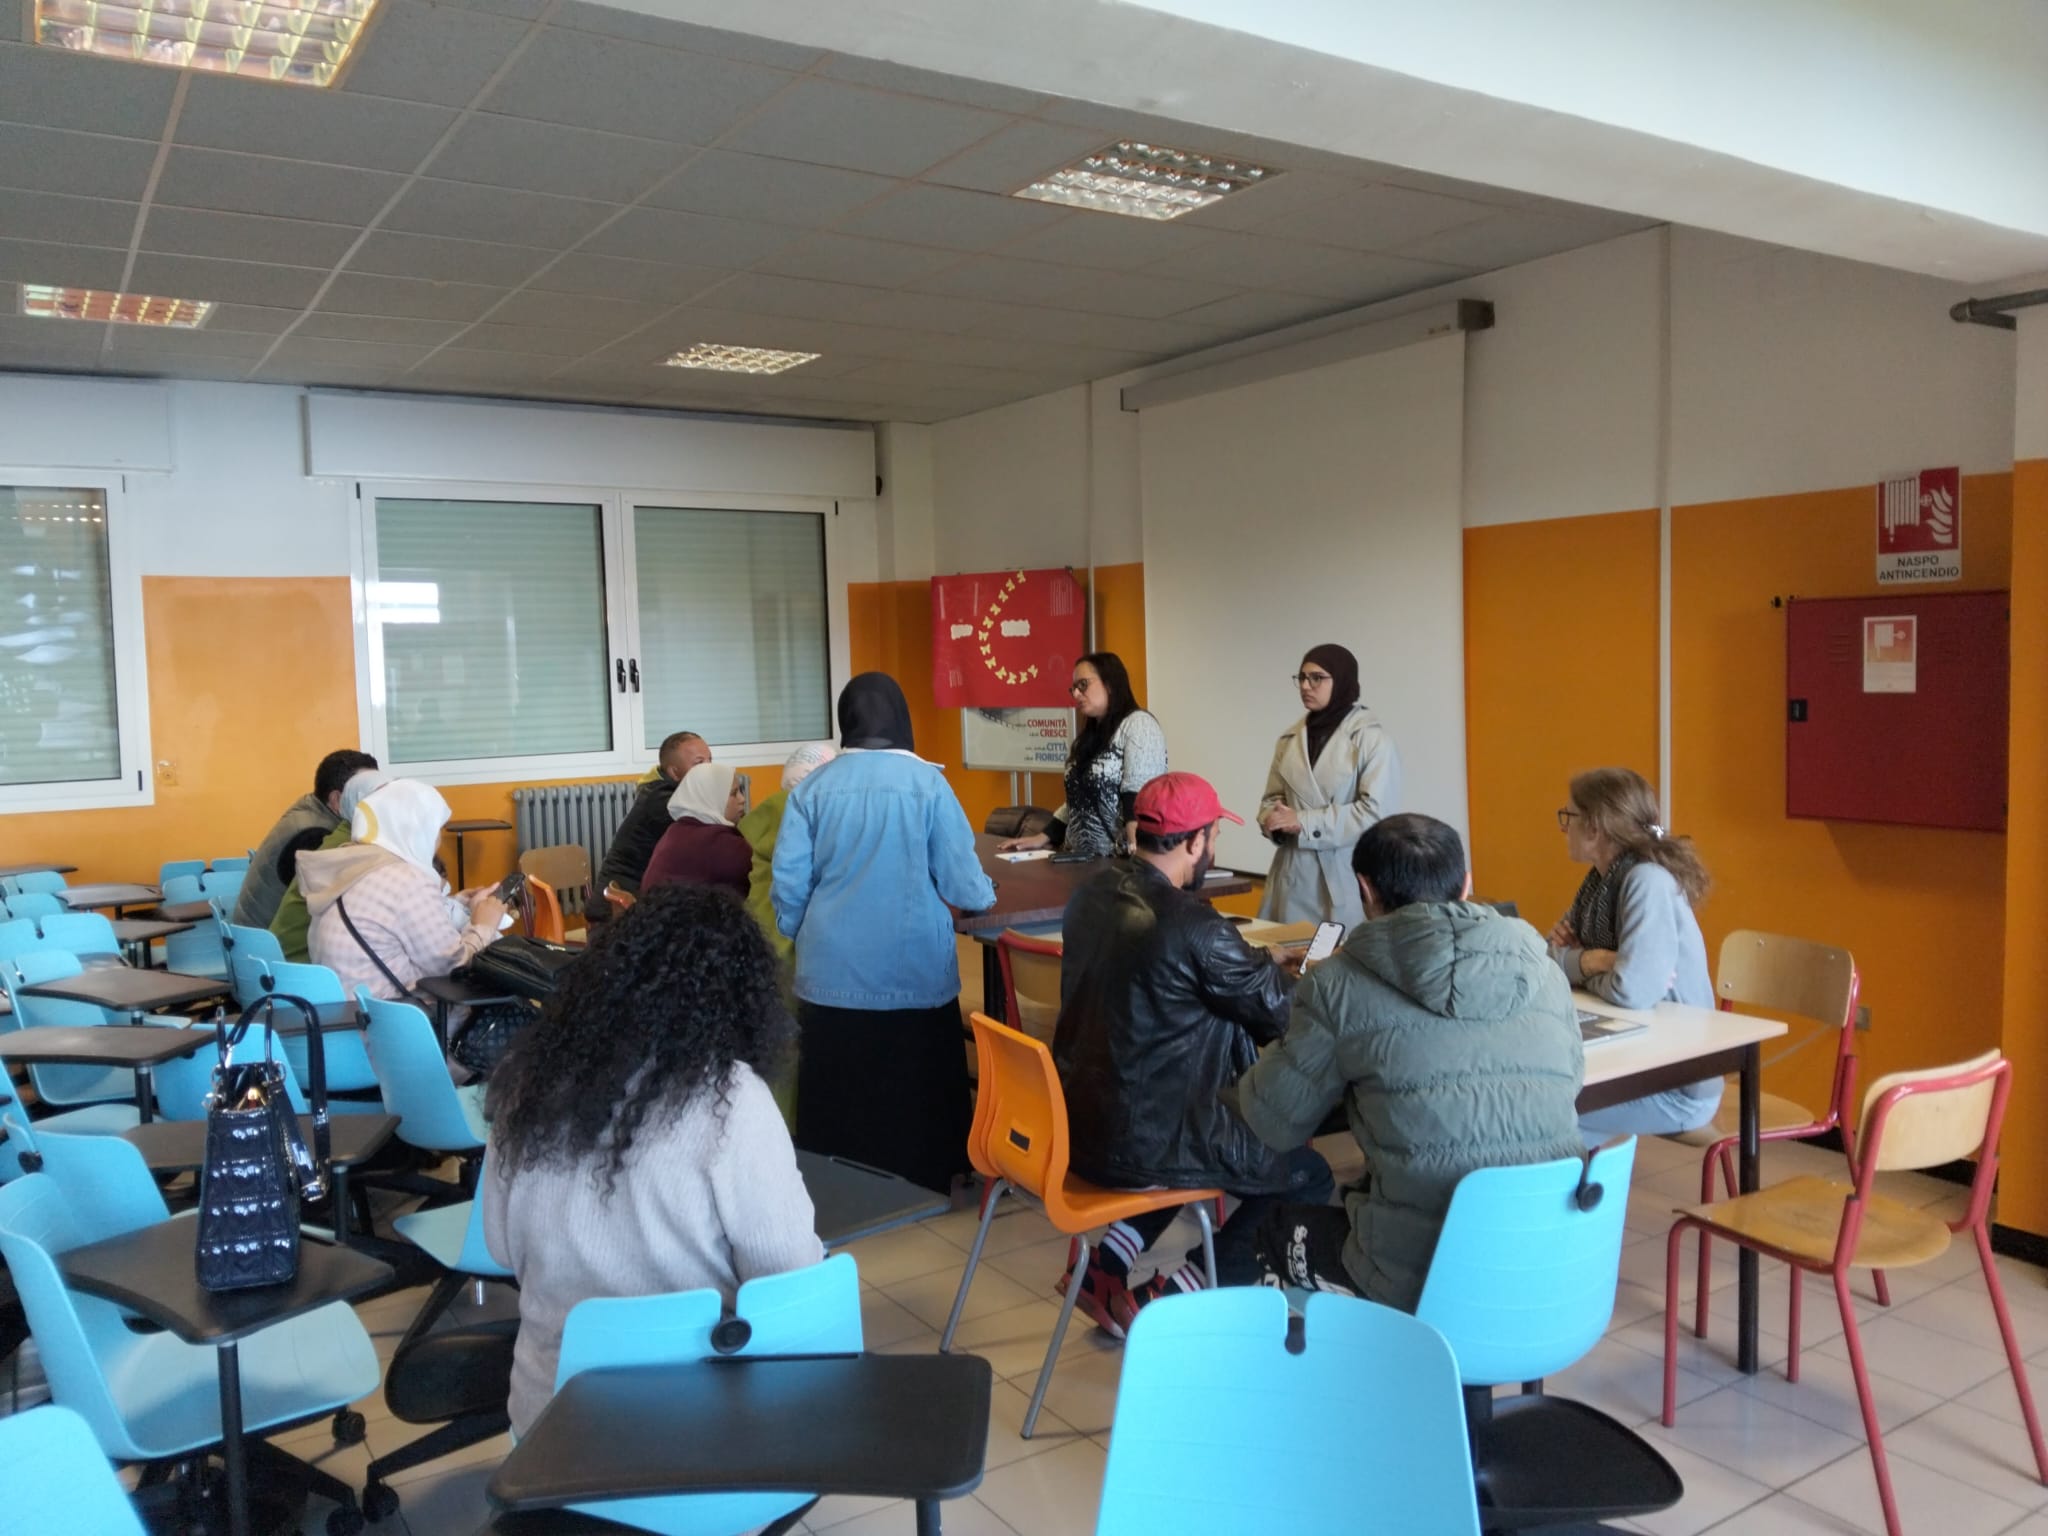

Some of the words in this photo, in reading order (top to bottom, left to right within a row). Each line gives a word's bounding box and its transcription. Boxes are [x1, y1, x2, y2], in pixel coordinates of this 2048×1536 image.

[1897, 555, 1939, 567] NASPO
[1879, 566, 1959, 580] ANTINCENDIO
[1027, 718, 1067, 728] COMUNITÀ
[1040, 729, 1067, 738] CRESCE
[1046, 741, 1067, 751] CITTÀ
